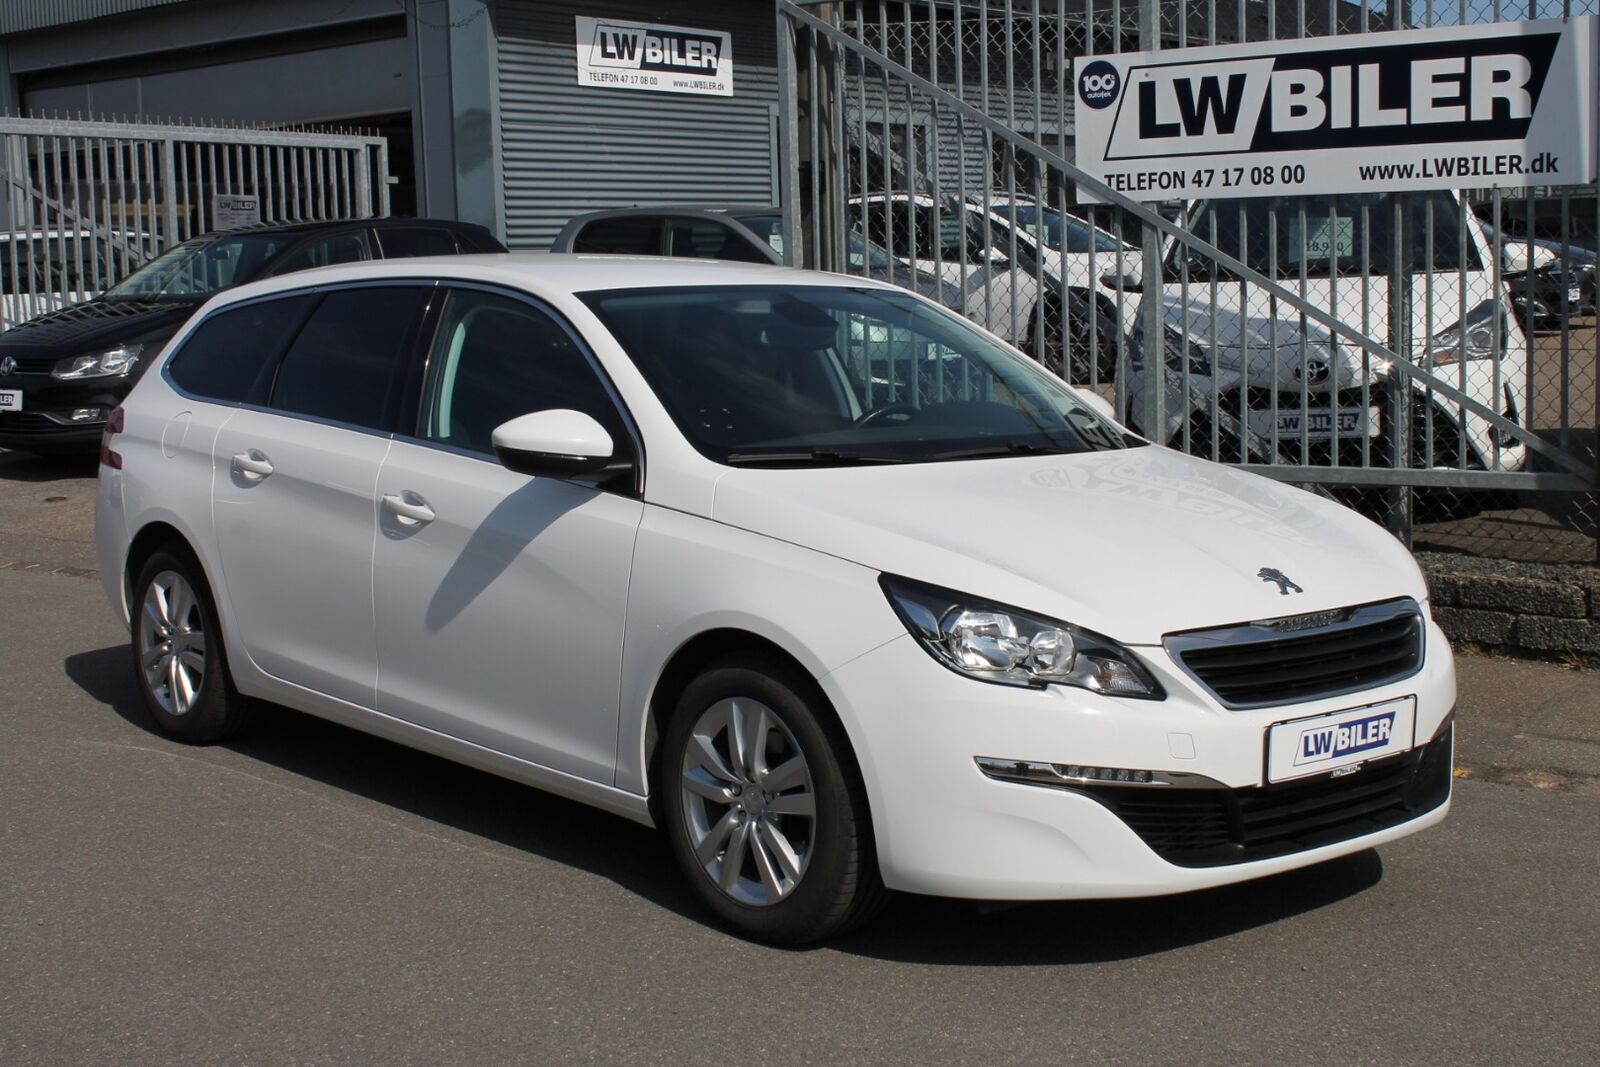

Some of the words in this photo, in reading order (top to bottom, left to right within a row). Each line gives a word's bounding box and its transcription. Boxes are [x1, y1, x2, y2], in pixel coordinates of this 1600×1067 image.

[600, 31, 638, 61] LW
[645, 35, 718, 69] BILER
[588, 72, 619, 83] TELEFON
[620, 76, 629, 84] 47
[630, 77, 639, 85] 17
[640, 77, 649, 85] 08
[649, 77, 658, 86] 00
[672, 80, 725, 91] www.LWBILER.dk
[1138, 73, 1248, 140] LW
[1270, 53, 1533, 133] BILER
[1104, 170, 1186, 192] TELEFON
[1191, 169, 1216, 188] 47
[1222, 167, 1244, 187] 17
[1250, 165, 1275, 186] 08
[1280, 164, 1306, 184] 00
[1359, 152, 1559, 181] www.LWBILER.dk
[1303, 731, 1333, 757] LW
[1336, 718, 1391, 751] BILER
